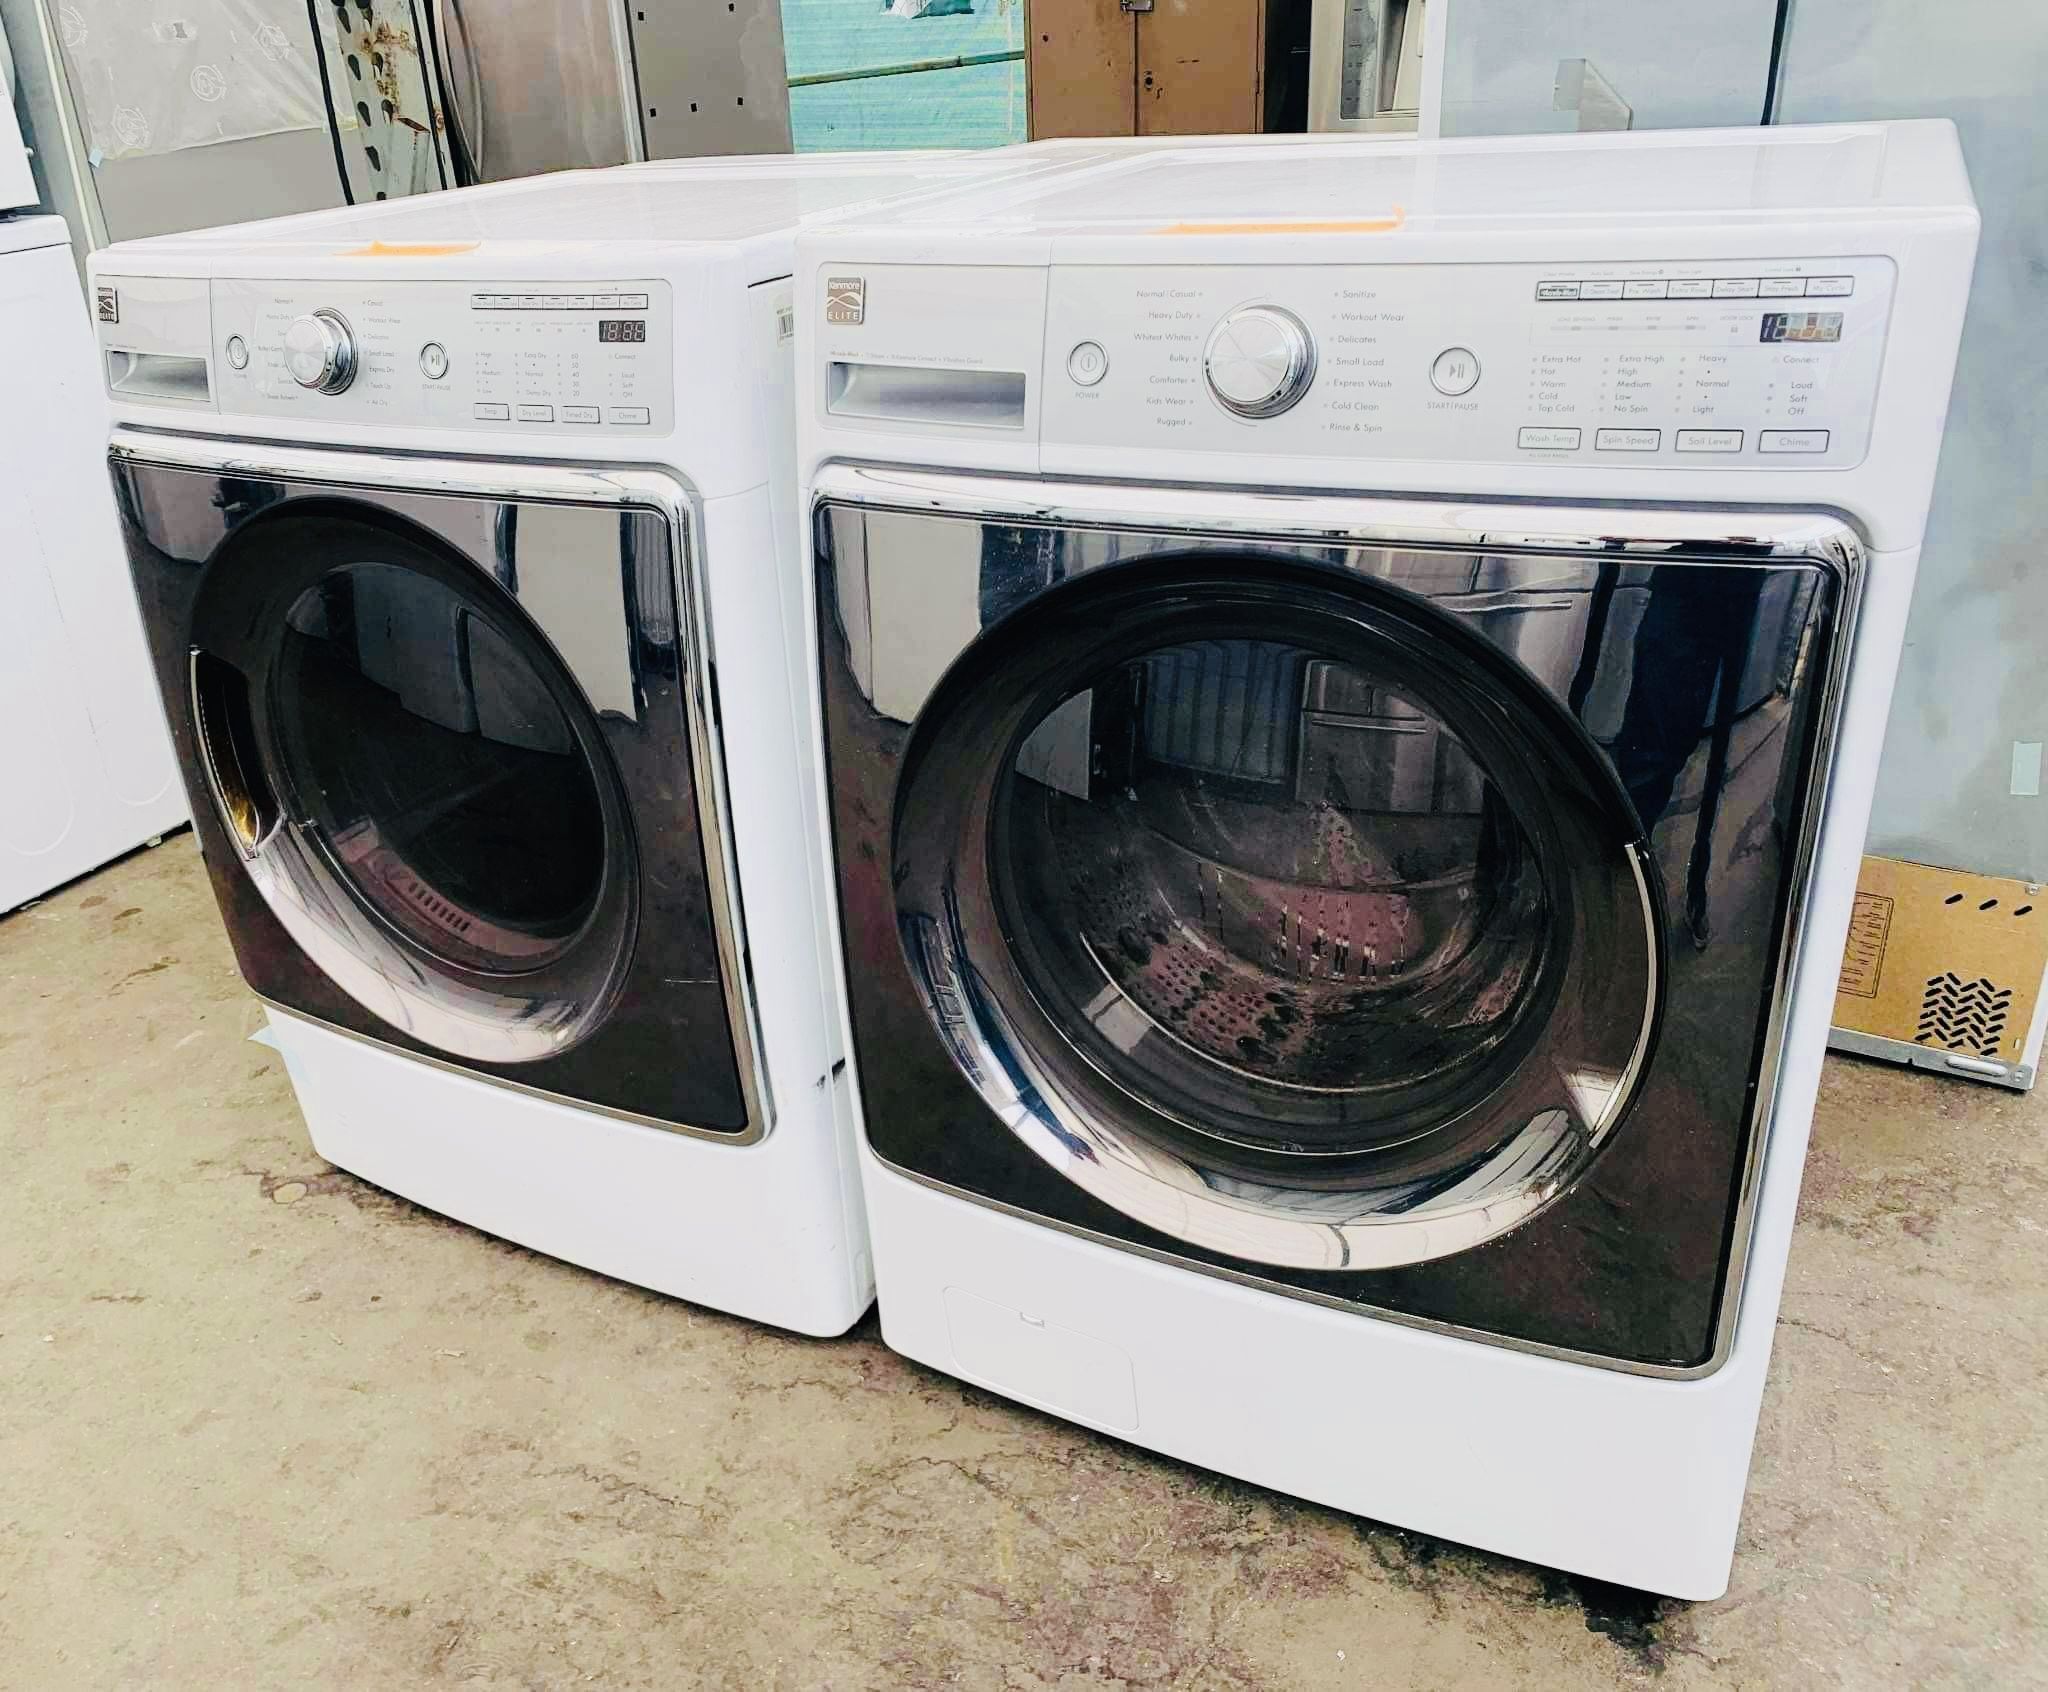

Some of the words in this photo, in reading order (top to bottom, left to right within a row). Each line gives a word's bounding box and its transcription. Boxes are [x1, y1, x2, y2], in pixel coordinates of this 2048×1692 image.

[1343, 289, 1376, 298] Sanitize
[828, 311, 860, 320] ELITE
[1149, 311, 1172, 320] Heavy
[1175, 312, 1193, 320] Duty
[1341, 313, 1377, 321] Workout
[1381, 314, 1404, 322] Wear
[1338, 335, 1376, 344] Delicates
[1170, 353, 1189, 363] Bulky
[1336, 358, 1360, 366] Small
[1362, 358, 1384, 367] Load
[1542, 355, 1564, 363] Extra
[1566, 355, 1581, 363] Hot
[1619, 355, 1641, 363] Extra
[1644, 355, 1665, 364] High
[1699, 355, 1727, 364] Heavy
[1783, 355, 1819, 364] Connect
[1618, 368, 1638, 377] High
[1149, 376, 1188, 384] Comforter
[1333, 380, 1365, 389] Express
[1368, 380, 1392, 388] Wash
[1696, 380, 1730, 388] Normal
[1075, 391, 1099, 399] POWER
[1615, 393, 1631, 401] Low
[1789, 394, 1808, 403] Soft
[1147, 397, 1162, 405] Kids
[1331, 401, 1351, 410] Cold
[1354, 402, 1379, 411] Clean
[1555, 404, 1575, 412] Cold
[1613, 405, 1627, 413] No
[1630, 405, 1648, 414] Spin
[1693, 406, 1714, 415] Light
[1787, 407, 1805, 416] Off
[1157, 417, 1185, 427] Rugged
[1329, 423, 1350, 431] Rinse
[1353, 423, 1360, 431] &
[1363, 423, 1382, 433] Spin
[1525, 434, 1550, 442] Wash
[1553, 434, 1575, 443] Temp
[1603, 435, 1622, 444] Spin
[1625, 436, 1654, 445] Speed
[1688, 437, 1705, 445] Soil
[1708, 437, 1732, 445] Level
[1779, 437, 1810, 446] Chime
